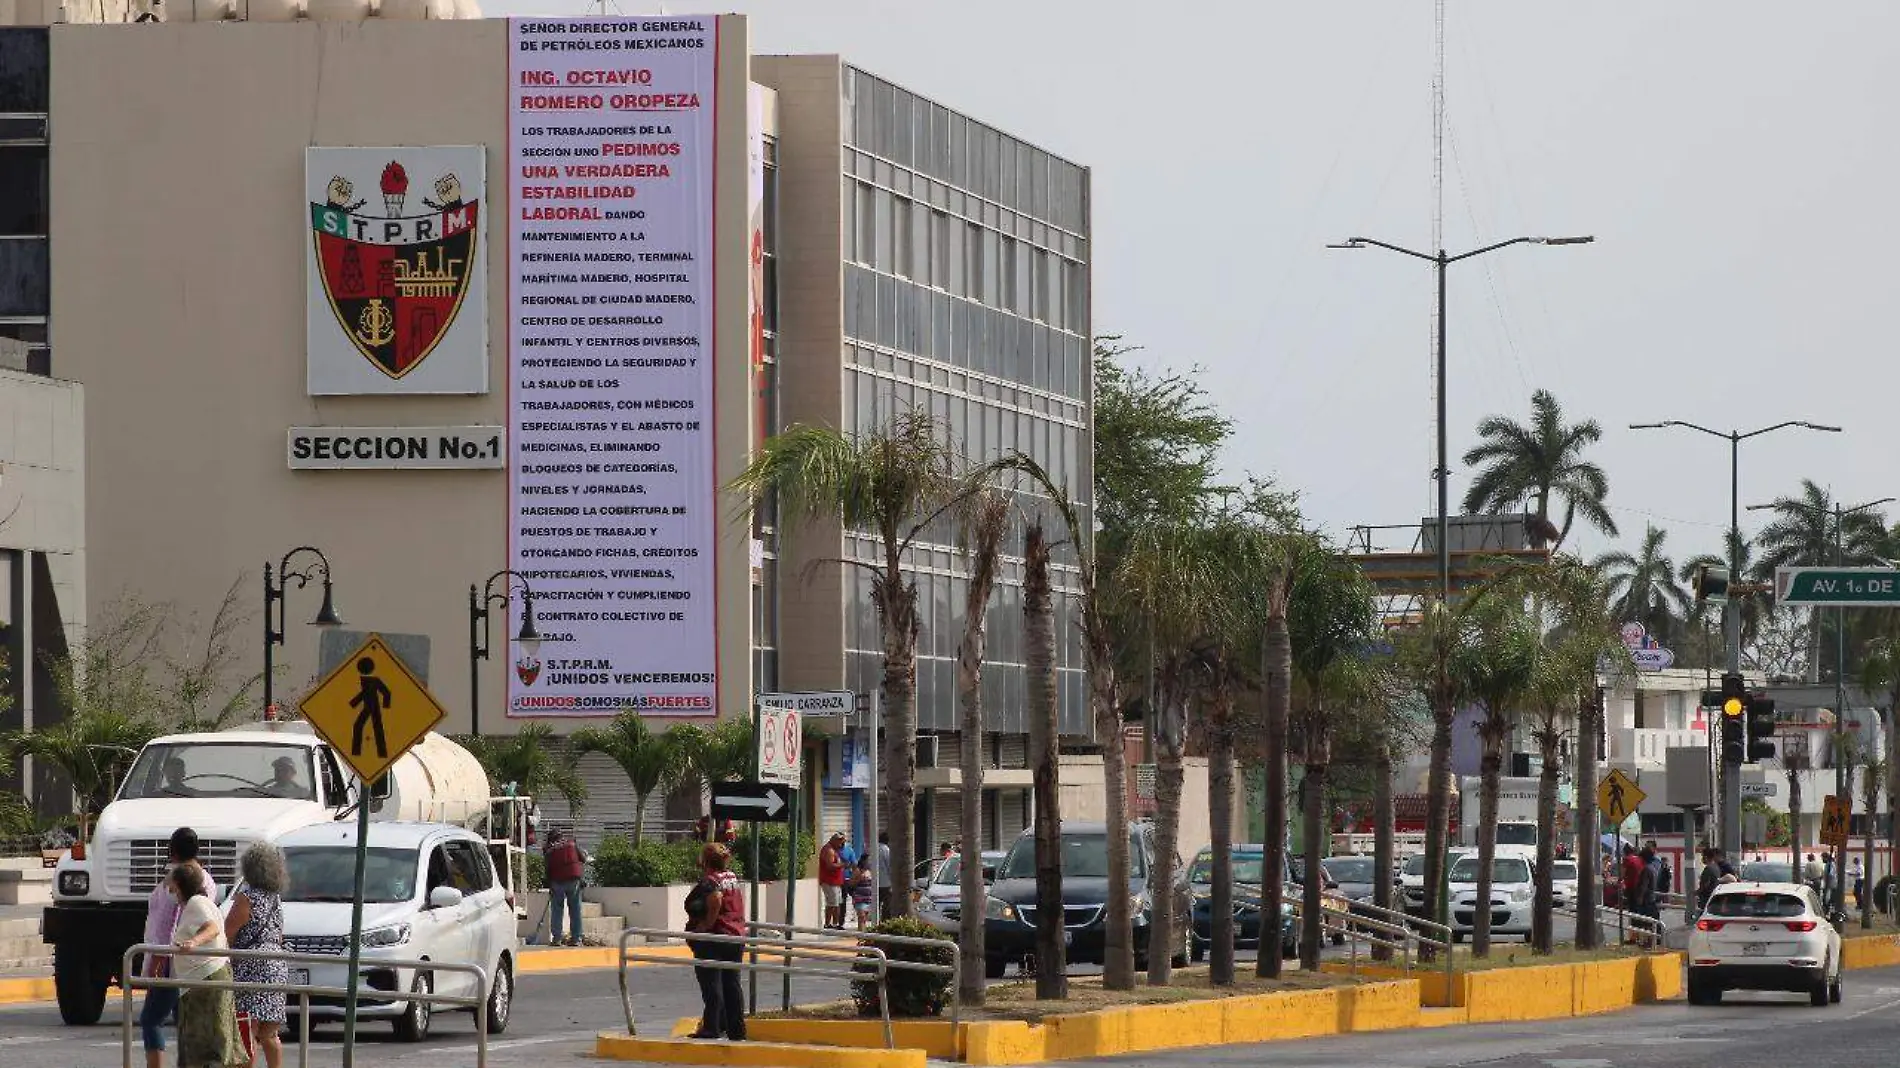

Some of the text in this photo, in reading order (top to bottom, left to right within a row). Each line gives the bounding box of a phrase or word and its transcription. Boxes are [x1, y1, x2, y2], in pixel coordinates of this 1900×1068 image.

[570, 22, 637, 33] DIRECTOR
[642, 21, 704, 32] GENERAL
[521, 38, 704, 51] DE PETRÓLEOS MEXICANOS
[520, 69, 652, 85] ING. OCTAVIO
[521, 94, 700, 109] ROMERO OROPEZA
[522, 126, 671, 136] LOS TRABAJADORES DE LA
[521, 143, 680, 157] SECCIÓN UNO PEDIMOS
[522, 164, 669, 178] UNA VERDADERA
[522, 186, 635, 199] ESTABILIDAD
[522, 207, 644, 220] LABORAL DANDO
[521, 232, 617, 241] MANTENIMIENTO
[631, 232, 644, 240] LA
[584, 253, 635, 263] MADERO,
[638, 253, 693, 261] TERMINAL
[522, 274, 689, 283] MARÍTIMA MADERO, HOSPITAL
[522, 295, 696, 304] REGIONAL DE CIUDAD MADERO,
[521, 316, 662, 325] CENTRO DE DESARROLLO
[522, 337, 699, 347] INFANTIL Y CENTROS DIVERSOS,
[605, 359, 619, 367] LA
[622, 358, 686, 367] SEGURIDAD
[522, 380, 619, 389] LA SALUD DE LOS
[520, 399, 694, 411] TRABAJADORES, CON MÉDICOS
[522, 422, 699, 431] ESPECIALISTAS Y EL ABASTO DE
[293, 436, 499, 459] SECCION No.1
[521, 443, 661, 452] MEDICINAS, ELIMINANDO
[522, 463, 677, 473] BLOQUEOS DE CATEGORÍAS,
[521, 484, 647, 494] NIVELES Y JORNADAS,
[521, 507, 579, 515] HACIENDO
[583, 507, 597, 515] LA
[599, 506, 670, 515] COBERTURA
[521, 527, 573, 537] PUESTOS
[575, 528, 591, 536] DE
[593, 528, 646, 538] TRABAJO
[521, 546, 699, 558] OTORGANDO FICHAS, CRÉDITOS
[521, 569, 674, 579] HIPOTECARIOS, VIVIENDAS,
[1812, 579, 1840, 593] AV.
[1868, 579, 1893, 593] DE
[520, 589, 603, 600] CAPACITACIÓN
[617, 591, 690, 600] CUMPLIENDO
[537, 612, 598, 620] CONTRATO
[601, 611, 666, 621] COLECTIVO
[669, 612, 683, 620] DE
[547, 660, 613, 670] S.T.P.R.M.
[547, 672, 715, 686] ¡UNIDOS VENCEREMOS!
[798, 697, 844, 710] CARRANZA
